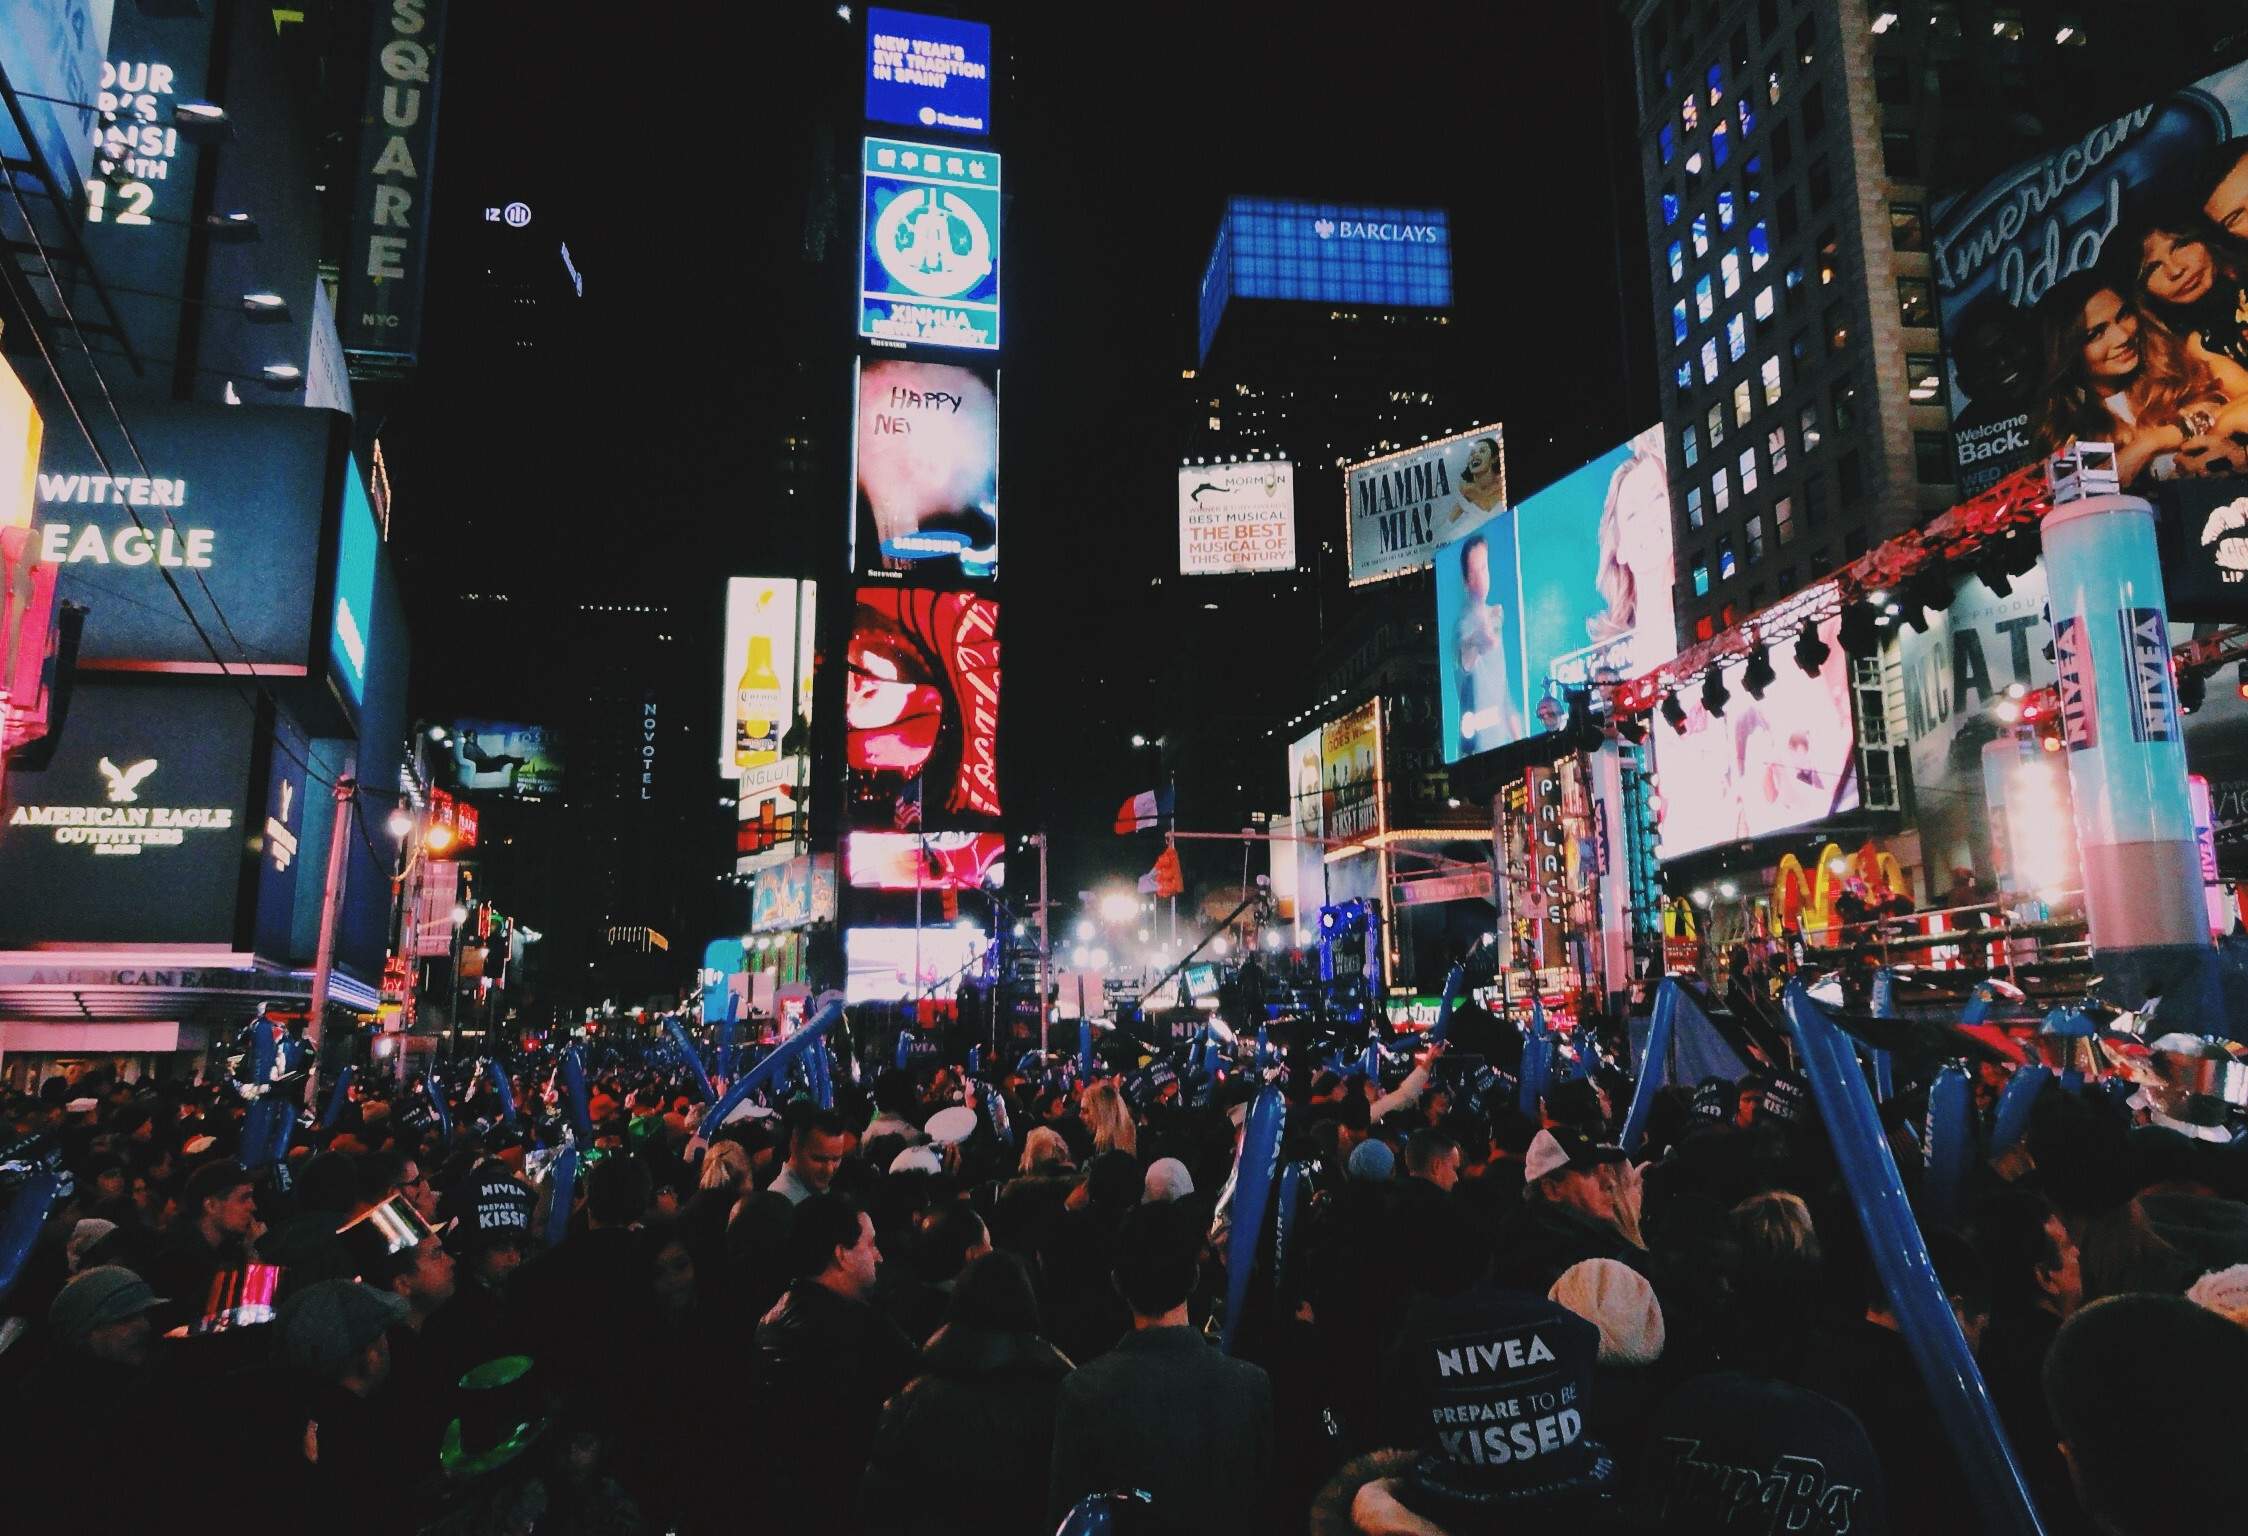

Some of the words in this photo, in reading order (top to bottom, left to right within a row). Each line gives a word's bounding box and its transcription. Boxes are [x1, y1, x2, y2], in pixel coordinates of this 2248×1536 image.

[874, 33, 910, 53] NEW
[366, 0, 430, 279] SQUARE
[86, 179, 154, 226] 12
[1932, 103, 2154, 289] American
[1340, 221, 1437, 243] BARCLAYS
[2002, 178, 2119, 308] Idol
[890, 386, 962, 413] HAPPY
[1956, 413, 2029, 443] Welcome
[1958, 429, 2030, 466] Back.
[1359, 457, 1450, 519] MAMMA
[1189, 514, 1221, 525] BEST
[1226, 510, 1286, 522] MUSICAL
[1234, 522, 1287, 540] BEST
[1379, 502, 1433, 555] MIA!
[40, 523, 215, 568] EAGLE
[1189, 540, 1260, 554] MUSICAL
[1264, 537, 1288, 551] OF
[1191, 554, 1221, 565] THIS
[641, 703, 657, 800] NOVOTEL
[10, 806, 148, 827] AMERICAN
[151, 807, 232, 828] EAGLE
[55, 827, 183, 845] OUTFITTERS
[1540, 779, 1562, 923] PALACE
[910, 1043, 938, 1054] IVEA
[481, 1183, 526, 1197] NIVEA
[1436, 1334, 1556, 1377] NIVEA
[1432, 1399, 1521, 1425] PREPARE
[1526, 1392, 1555, 1413] TO
[1561, 1382, 1577, 1406] BE
[1438, 1408, 1582, 1465] KISSED
